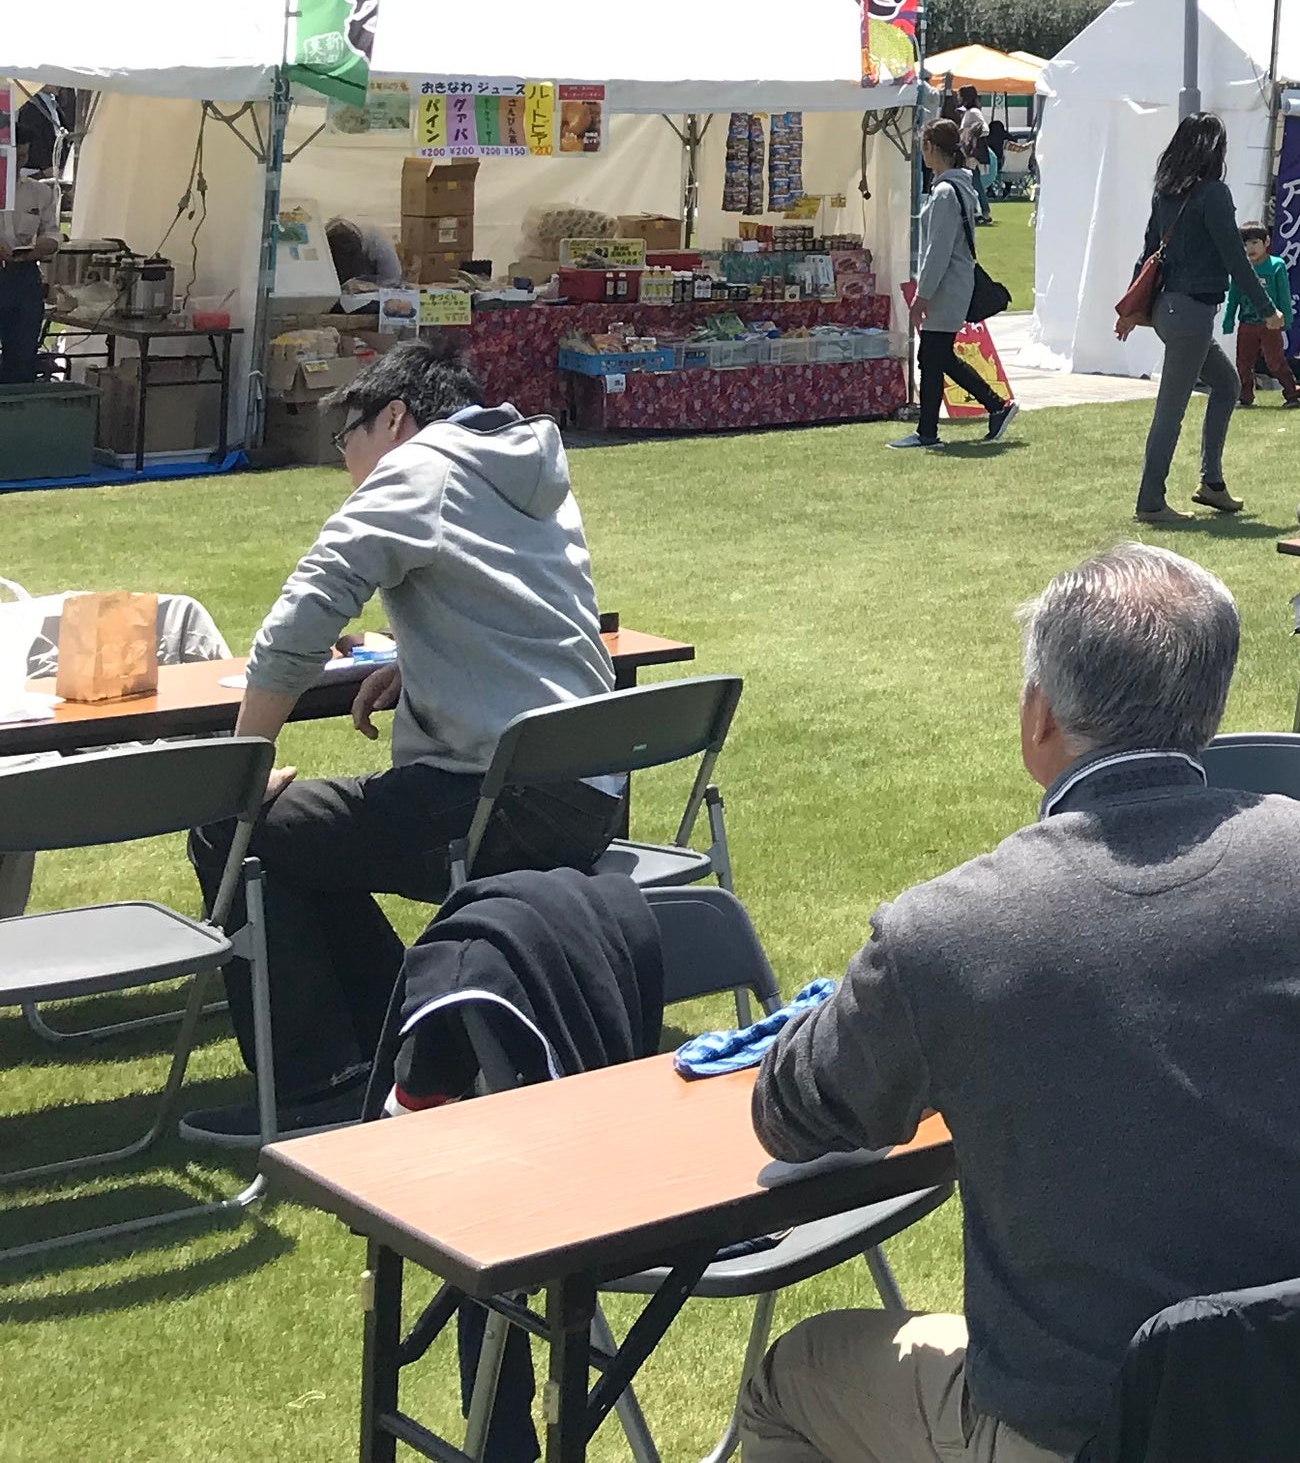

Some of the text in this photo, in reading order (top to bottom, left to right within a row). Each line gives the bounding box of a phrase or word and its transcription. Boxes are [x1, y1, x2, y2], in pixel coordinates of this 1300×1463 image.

[421, 81, 473, 94] おきなわ
[477, 81, 525, 95] ジュース
[426, 98, 441, 144] パイン
[450, 146, 474, 155] ¥200
